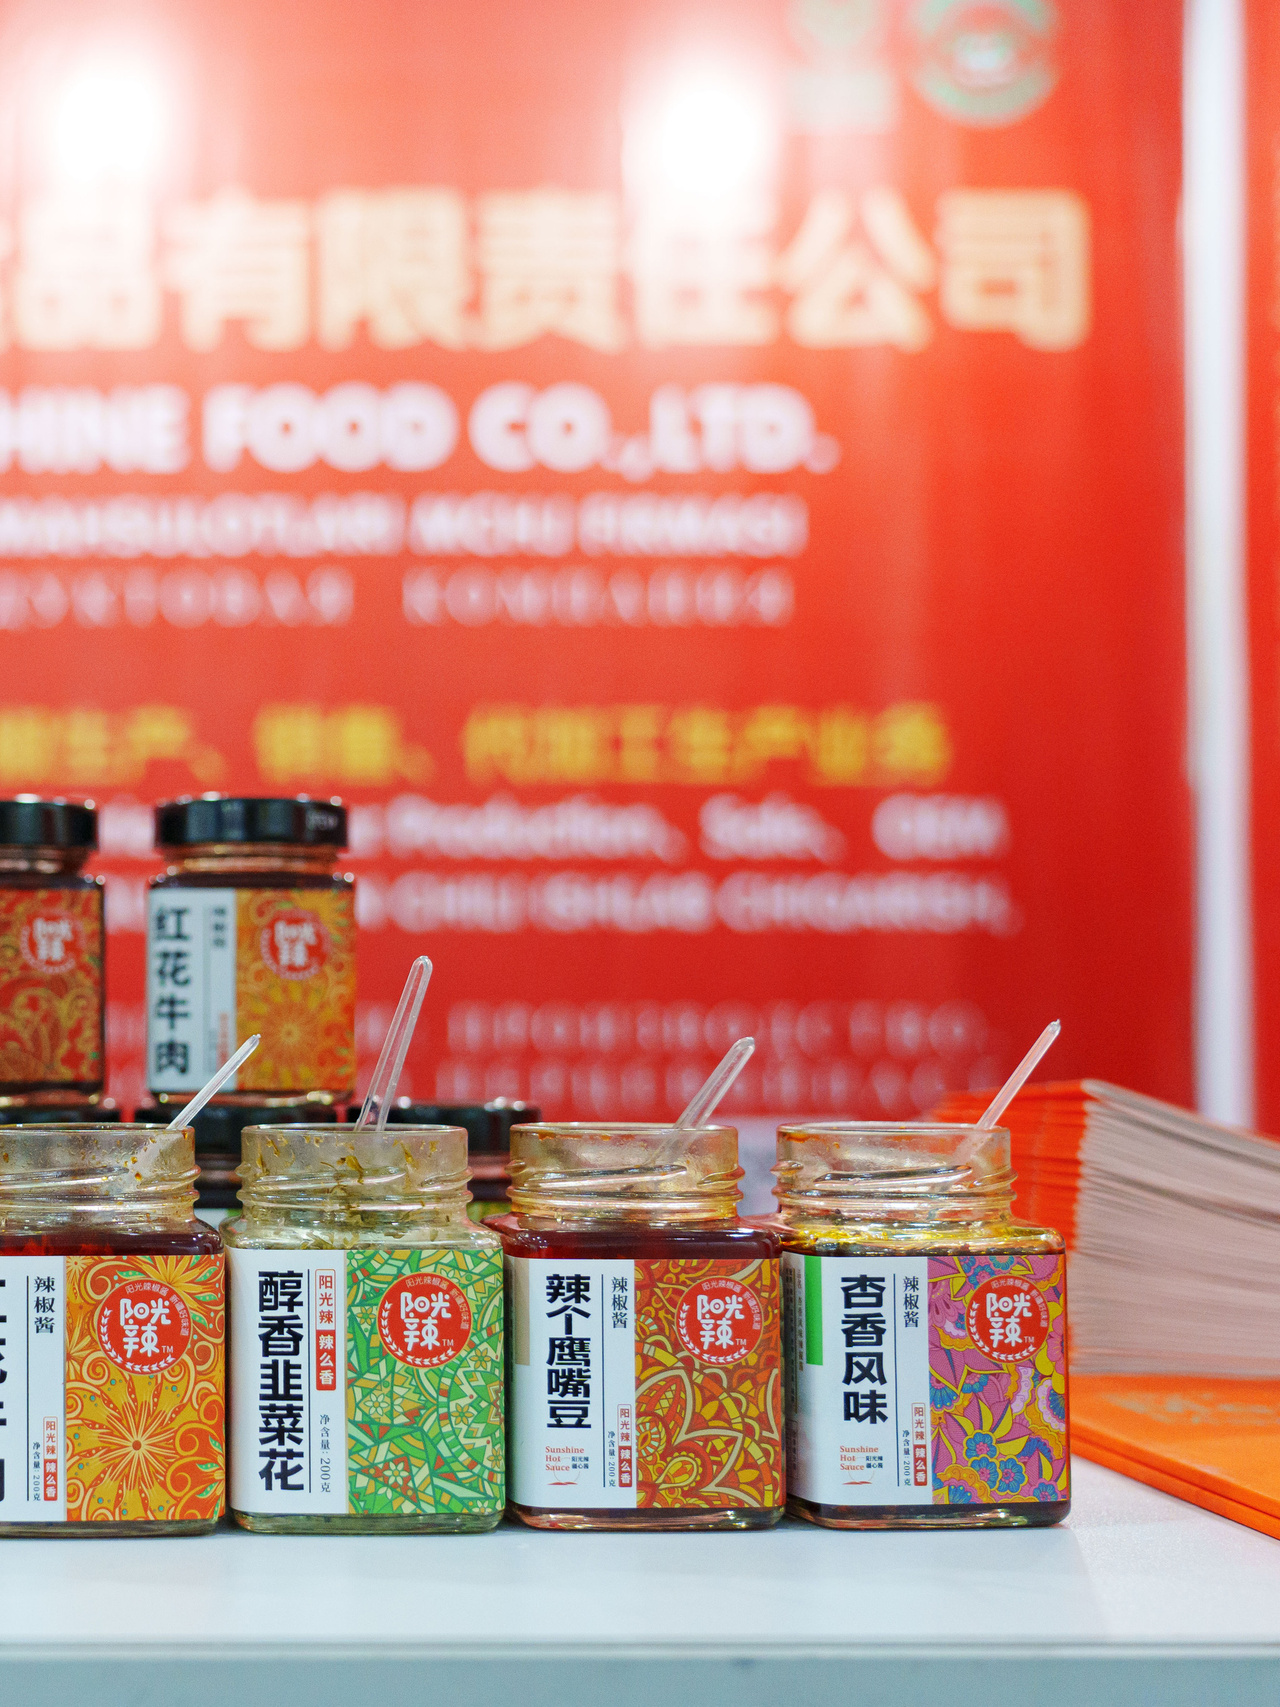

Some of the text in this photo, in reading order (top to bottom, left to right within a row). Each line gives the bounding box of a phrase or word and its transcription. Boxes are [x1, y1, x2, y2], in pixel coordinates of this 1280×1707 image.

[202, 383, 458, 473] FOOD
[155, 907, 192, 1077] 红花牛肉
[34, 1276, 55, 1333] 辣椒酱
[119, 1299, 171, 1326] 阳光
[400, 1292, 452, 1319] 阳光
[611, 1277, 628, 1328] 辣椒酱
[697, 1295, 744, 1321] 阳光
[903, 1276, 920, 1328] 辣椒酱
[986, 1293, 1031, 1318] 阳光
[123, 1323, 159, 1358] 辣
[318, 1275, 334, 1385] 阳光辣 辣么香
[404, 1316, 439, 1351] 辣
[546, 1274, 592, 1429] 辣个鹰嘴豆
[700, 1317, 734, 1349] 辣
[841, 1275, 888, 1425] 杏香风味
[990, 1316, 1021, 1348] 辣
[258, 1270, 304, 1491] 醇香韭菜花
[45, 1421, 56, 1498] 阳光辣 辣么香
[545, 1446, 584, 1454] Sunshine
[545, 1464, 570, 1472] Sauce
[620, 1409, 631, 1484] 阳光辣 辣么香
[840, 1463, 864, 1471] Sauce
[914, 1407, 926, 1482] 阳光辣 辣么香
